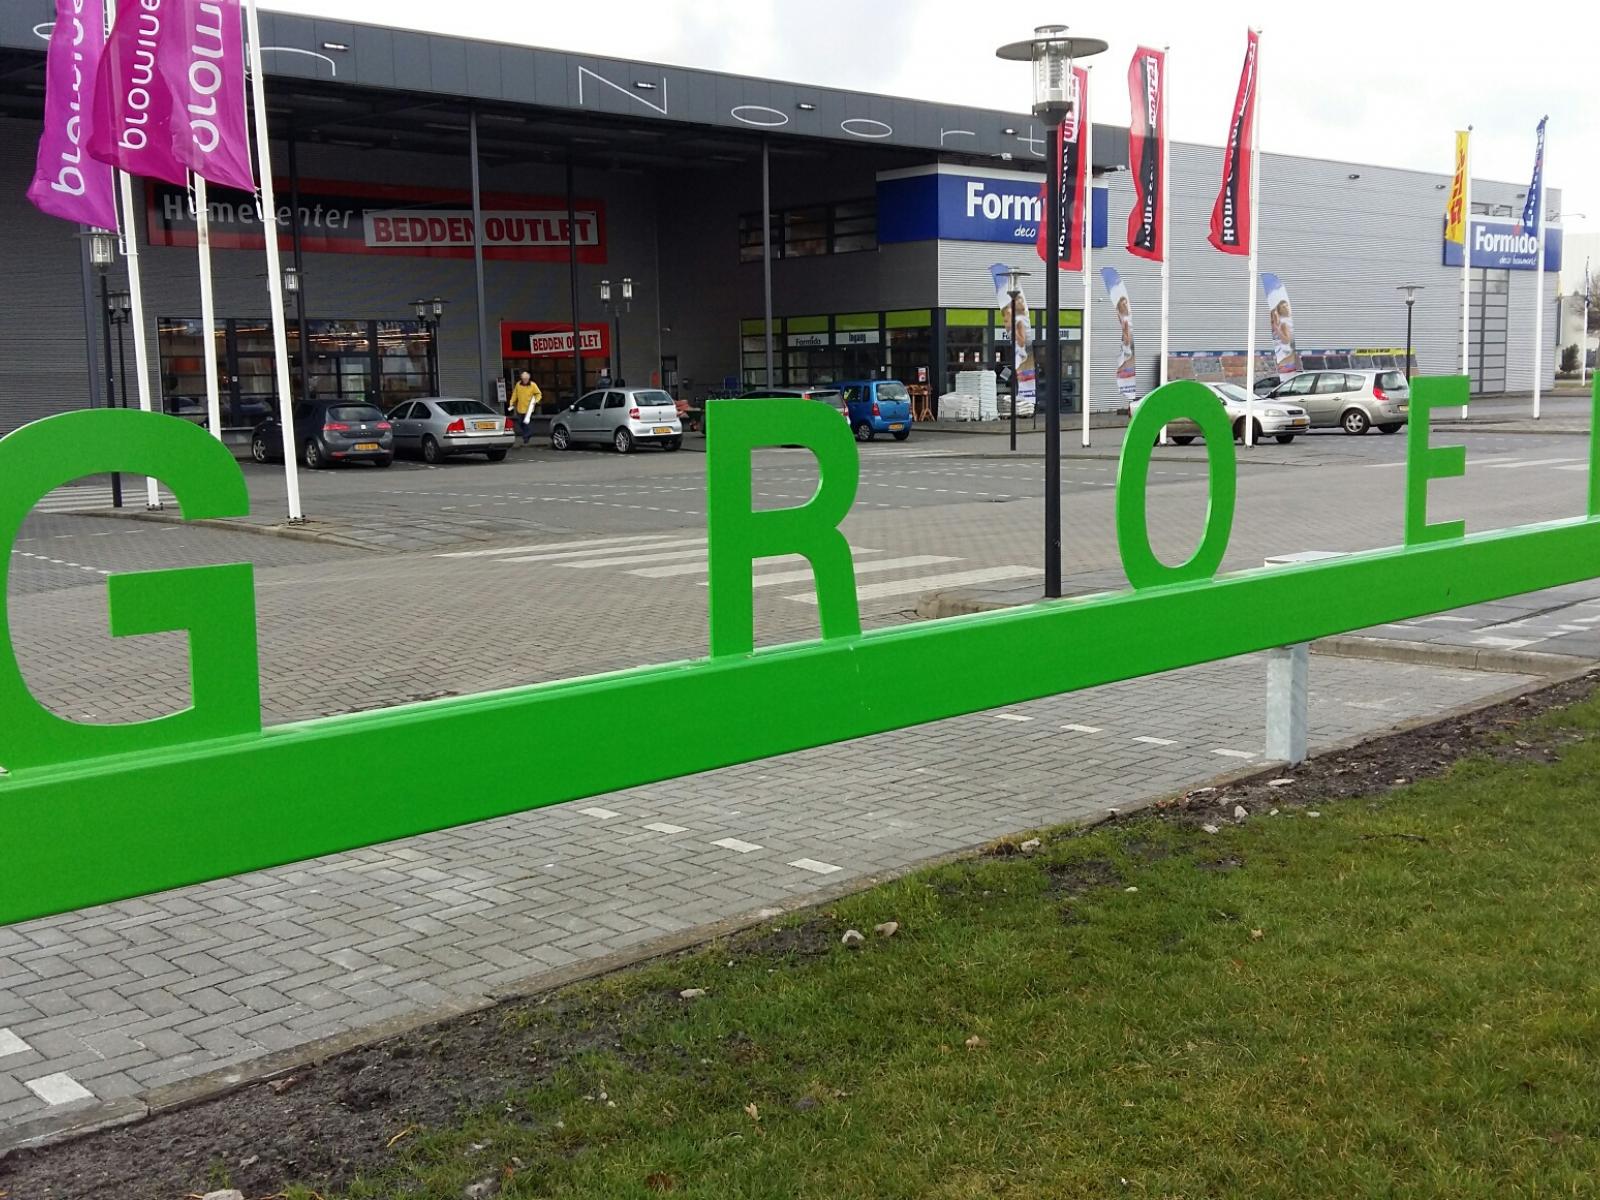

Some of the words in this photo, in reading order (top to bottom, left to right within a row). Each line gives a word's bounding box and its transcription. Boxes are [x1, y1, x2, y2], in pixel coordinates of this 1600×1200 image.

[967, 182, 1045, 221] Form
[373, 217, 475, 243] BEDDEN
[485, 218, 591, 242] OUTLET
[1014, 225, 1036, 238] deco
[1475, 225, 1537, 254] Formido
[533, 337, 564, 351] BEDDEN
[0, 368, 1600, 774] GROE
